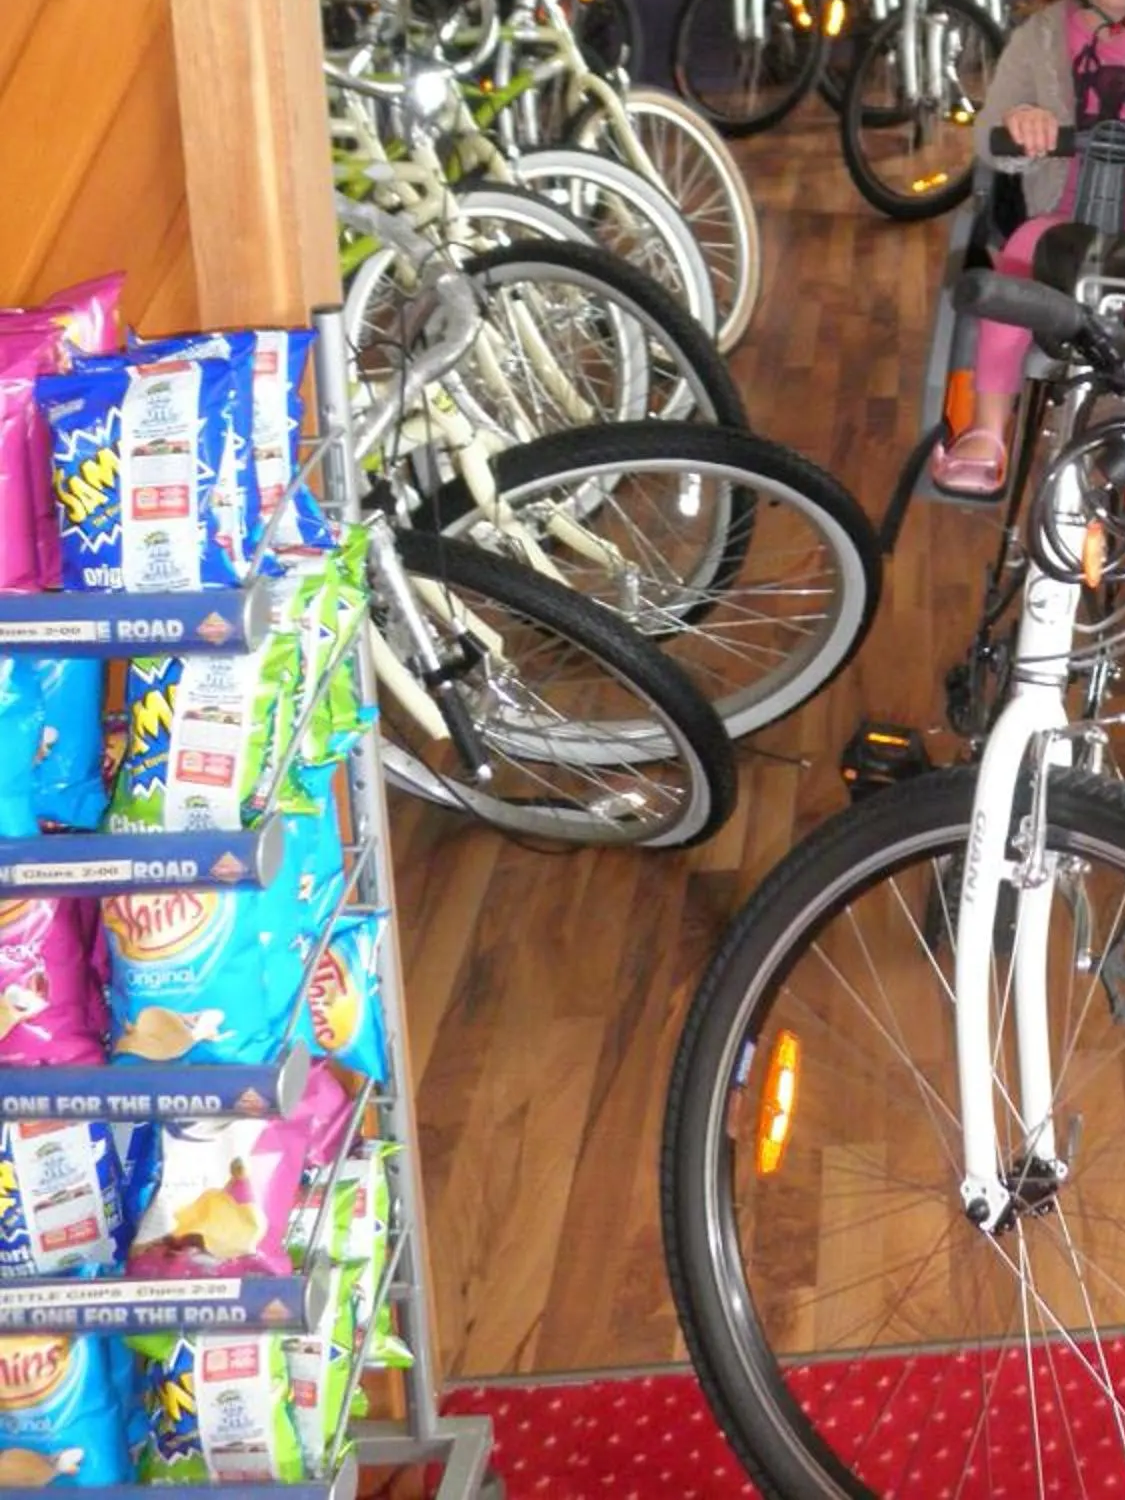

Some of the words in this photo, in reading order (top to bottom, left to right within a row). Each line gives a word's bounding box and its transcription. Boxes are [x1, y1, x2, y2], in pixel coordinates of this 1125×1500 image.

[117, 619, 184, 643] ROAD
[964, 809, 987, 903] GIANT
[133, 861, 198, 878] ROAD
[3, 1096, 49, 1115] ONE
[56, 1096, 101, 1114] FOR
[107, 1095, 151, 1113] THE
[157, 1095, 222, 1112] ROAD
[31, 1308, 77, 1325] ONE
[83, 1307, 128, 1325] FOR
[134, 1306, 180, 1323] THE
[184, 1306, 247, 1323] ROAD
